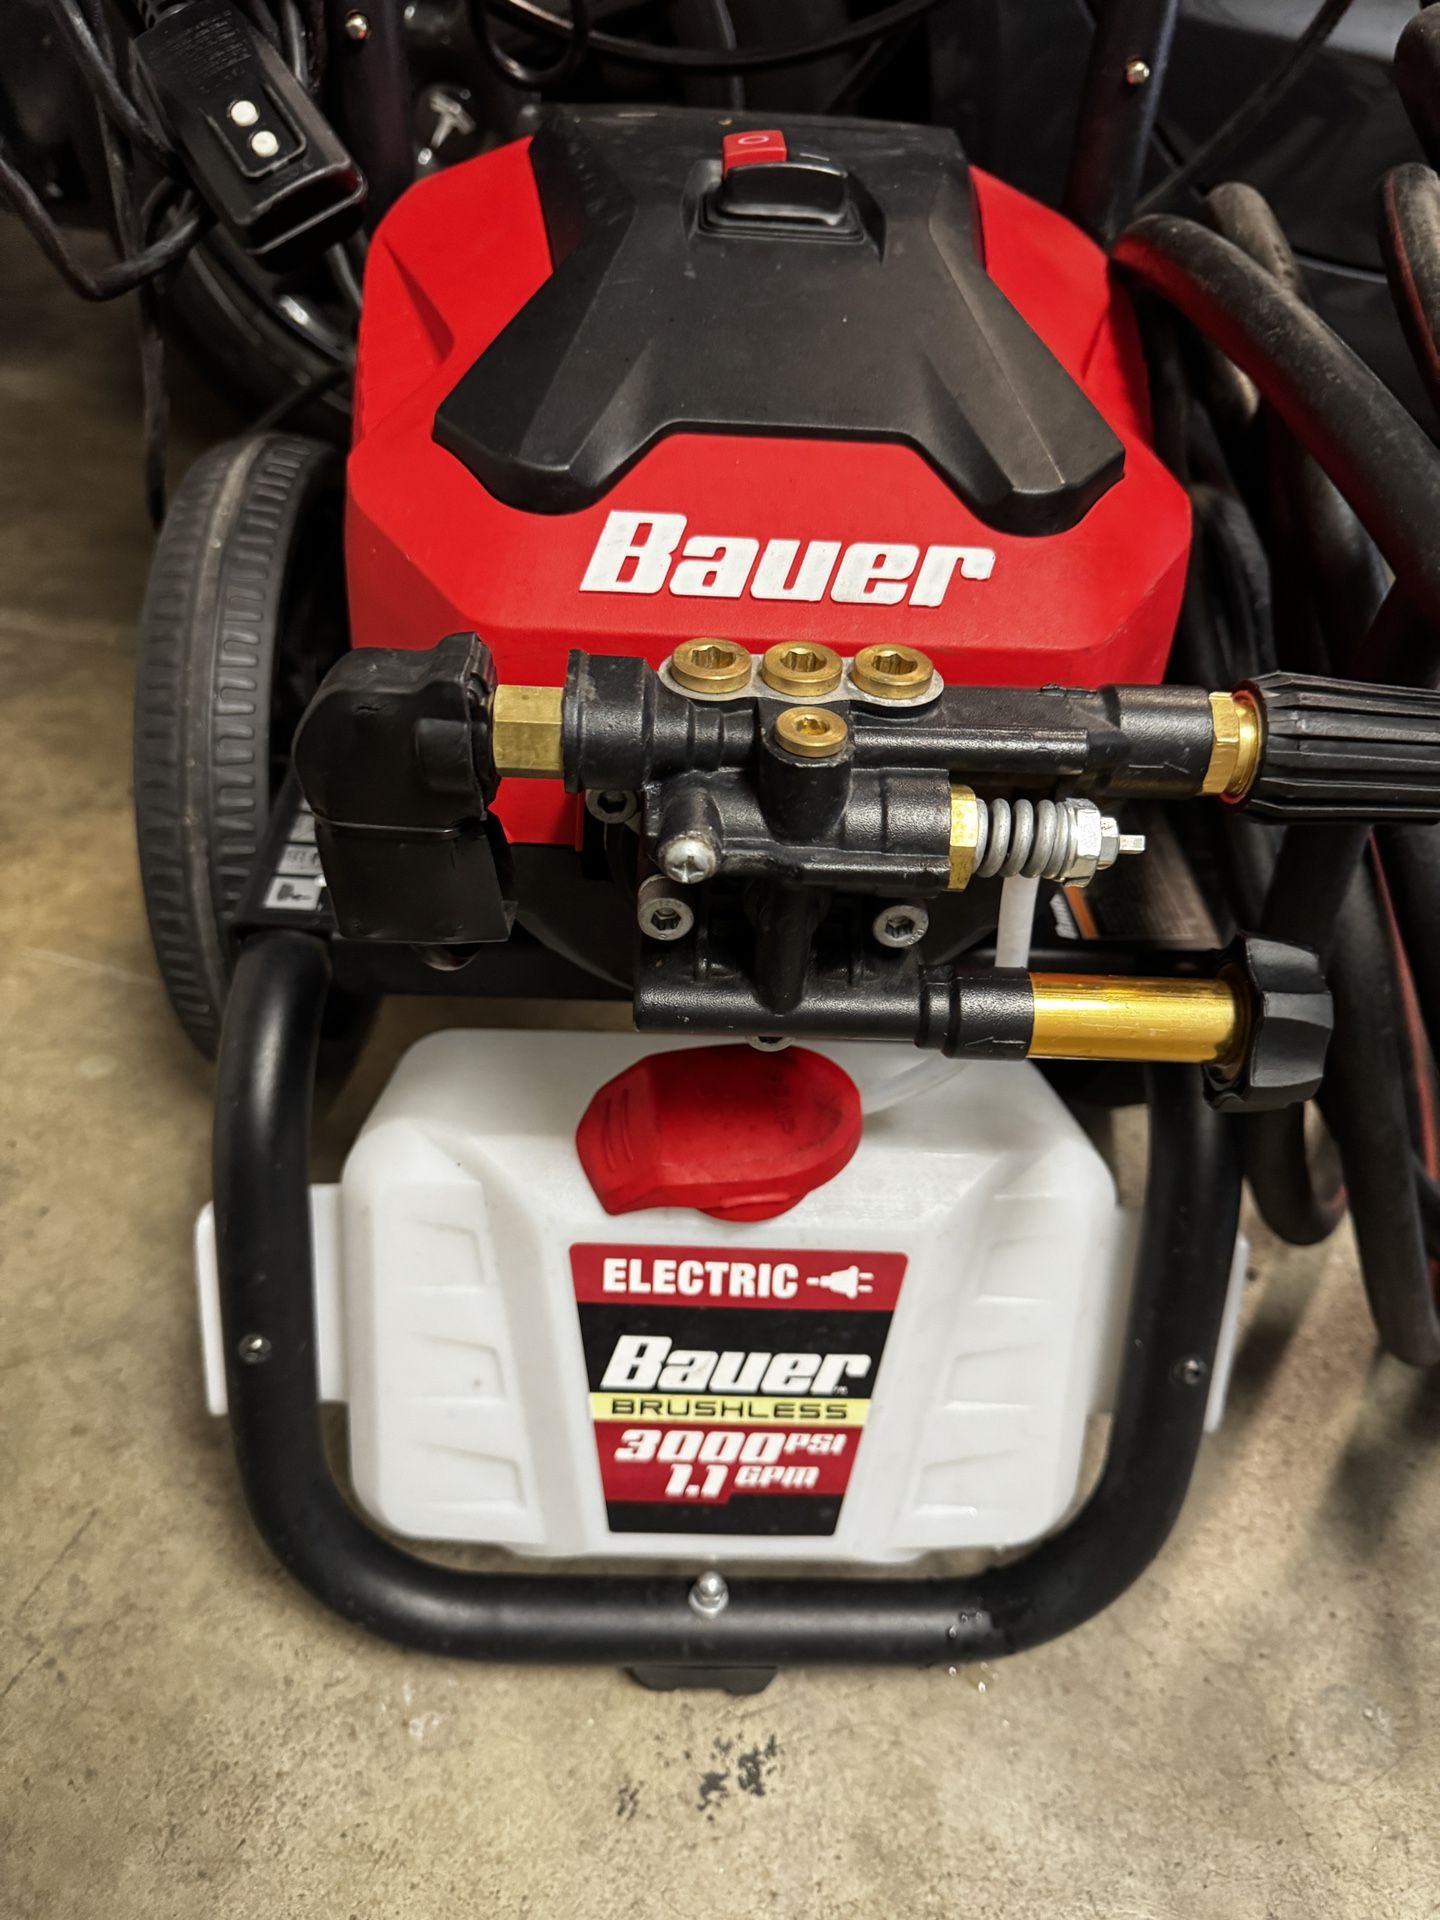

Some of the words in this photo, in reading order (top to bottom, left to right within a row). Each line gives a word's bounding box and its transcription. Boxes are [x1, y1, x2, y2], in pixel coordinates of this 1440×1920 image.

[579, 510, 996, 607] Bauer
[602, 1257, 799, 1299] ELECTRIC
[600, 1334, 871, 1395] Bauer
[611, 1398, 847, 1420] BRUSHLESS
[613, 1429, 786, 1464] 3000
[784, 1432, 847, 1456] PSI
[664, 1463, 729, 1499] 1.1
